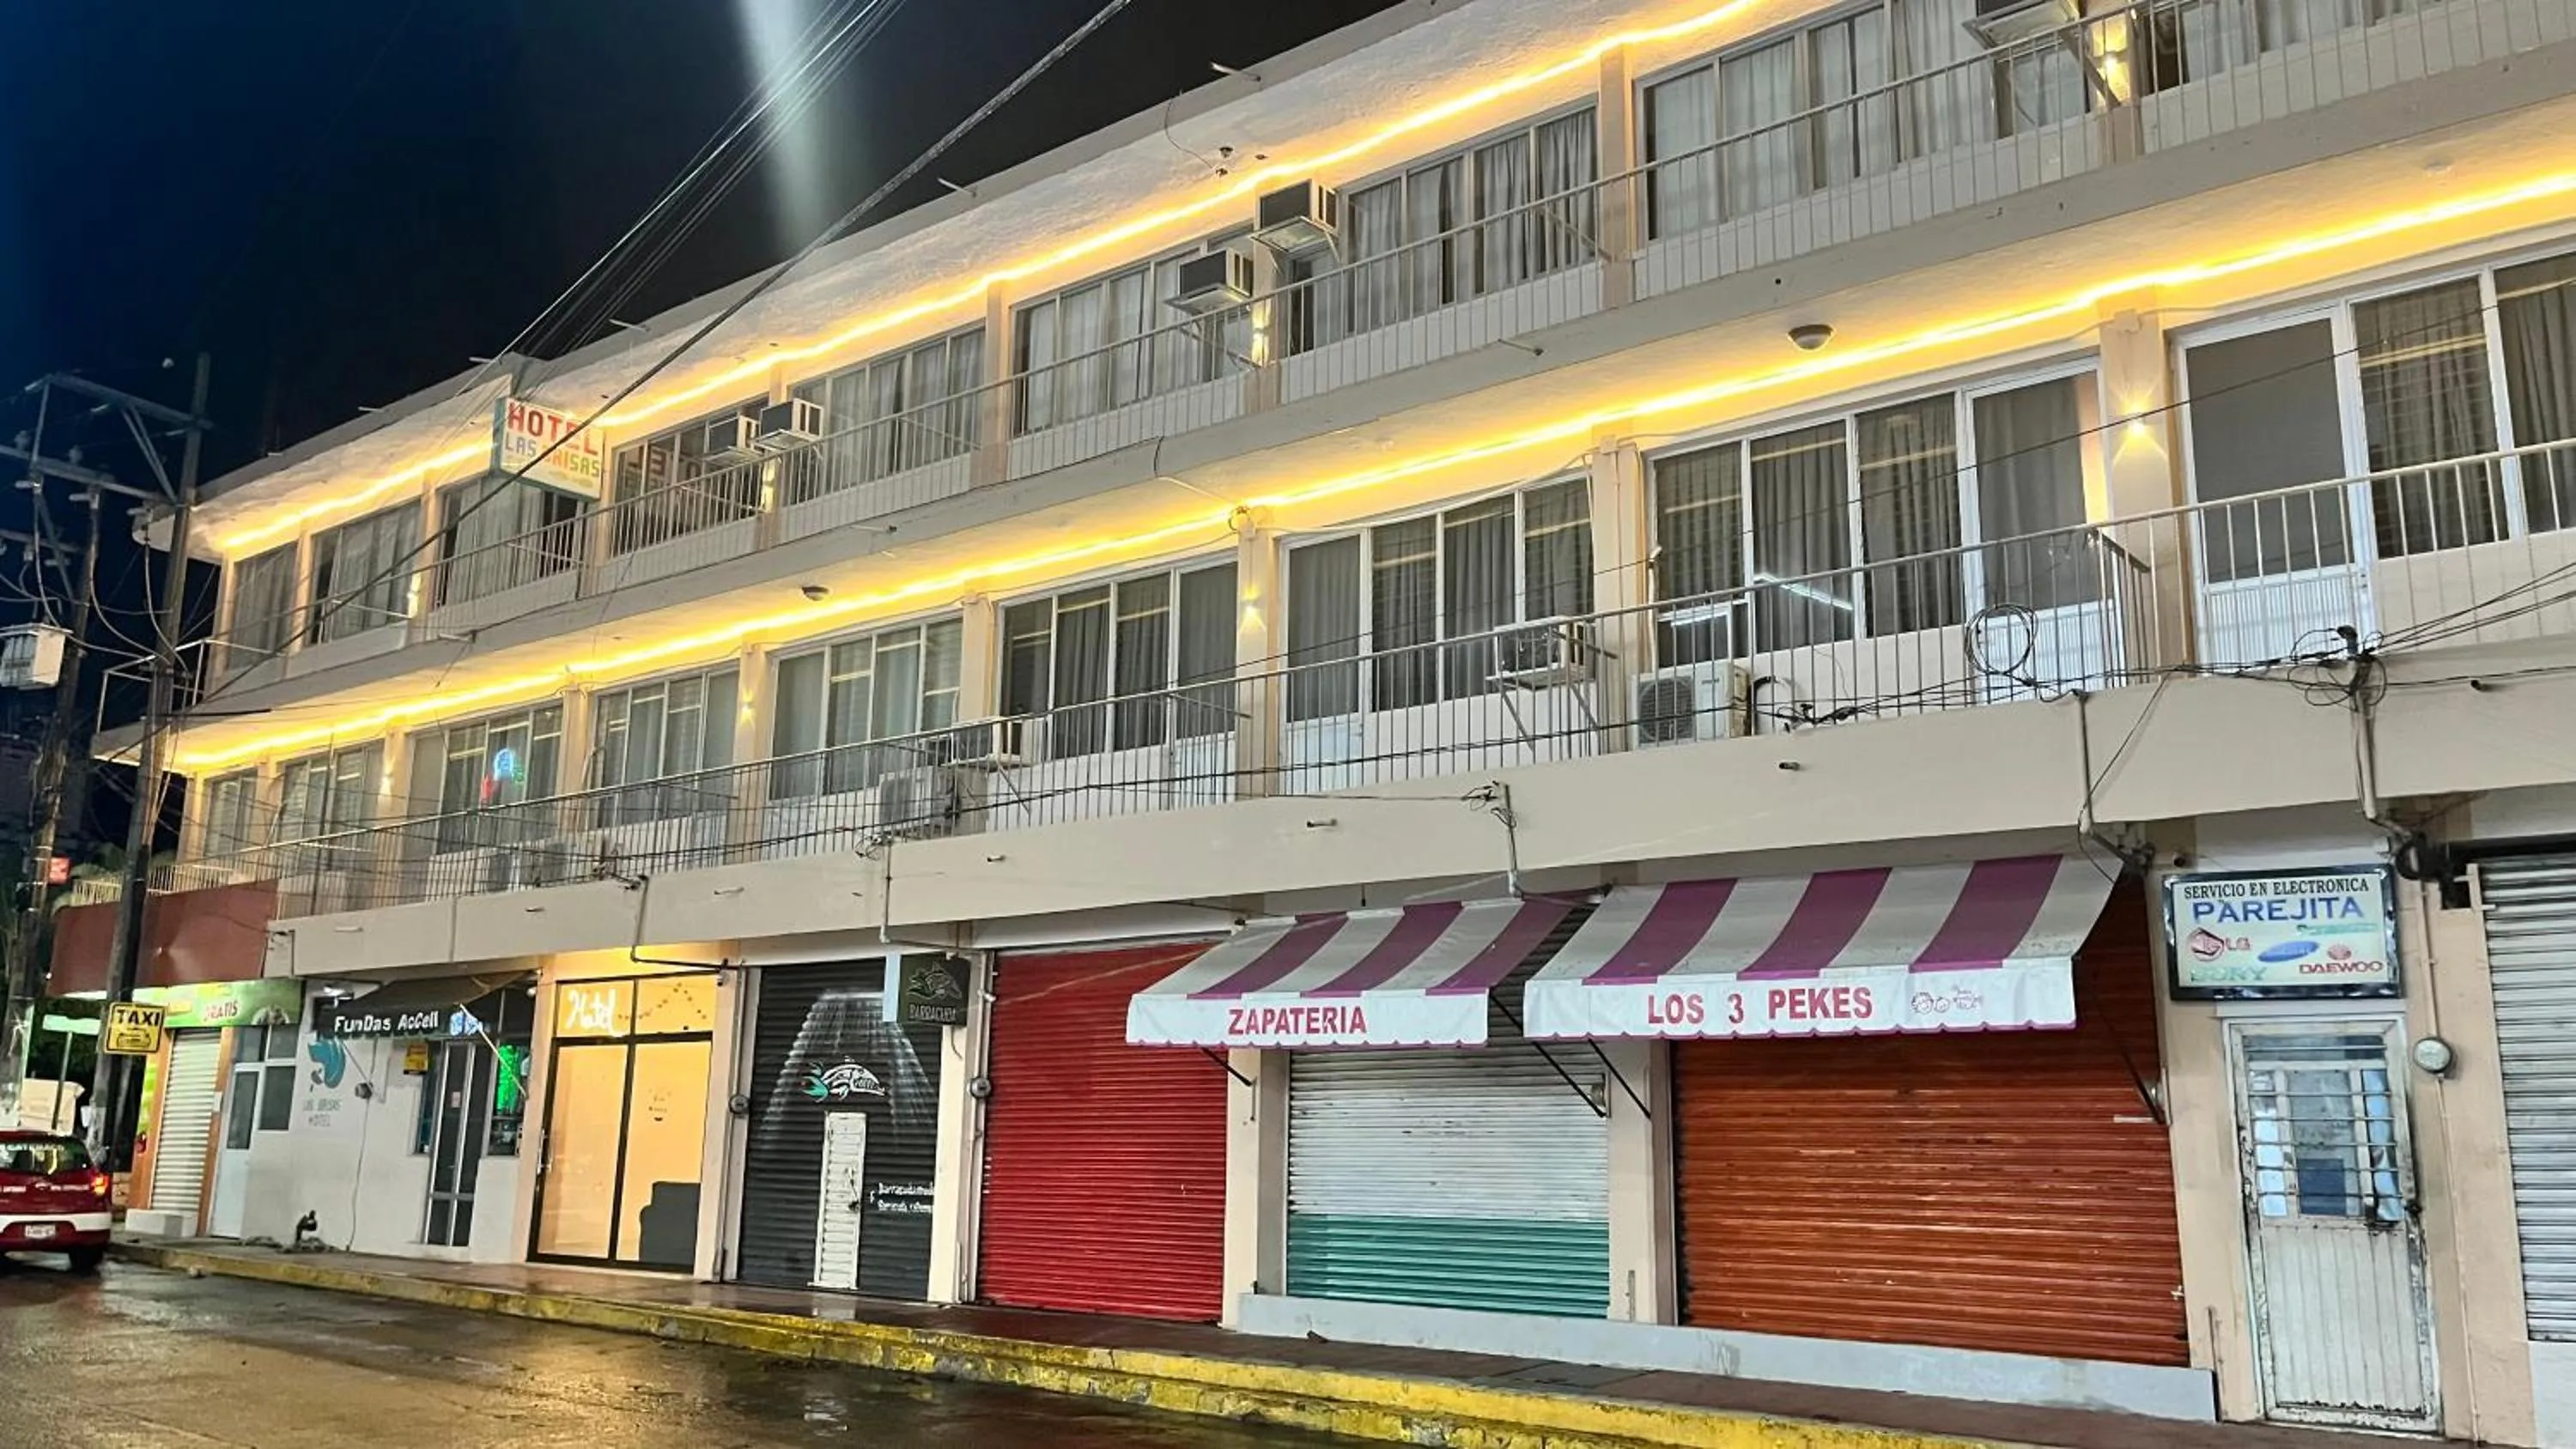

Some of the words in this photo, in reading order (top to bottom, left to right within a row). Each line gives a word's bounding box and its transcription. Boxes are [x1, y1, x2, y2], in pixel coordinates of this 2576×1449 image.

[507, 402, 598, 456] HOTEL
[505, 432, 537, 458] LAS
[541, 444, 600, 478] RISAS
[2184, 882, 2245, 900] SERVICIO
[2250, 882, 2269, 896] EN
[2273, 877, 2369, 894] ELECTRONICA
[2192, 896, 2363, 923] PAREJITA
[2226, 937, 2251, 951] LG
[2299, 960, 2384, 975] DAEWOO
[117, 1009, 160, 1027] TAXI
[1648, 993, 1704, 1025] LOS
[1728, 992, 1744, 1024] 3
[1768, 986, 1873, 1020] PEKES
[334, 1014, 392, 1032] FunDas
[1228, 1005, 1368, 1035] ZAPATERIA
